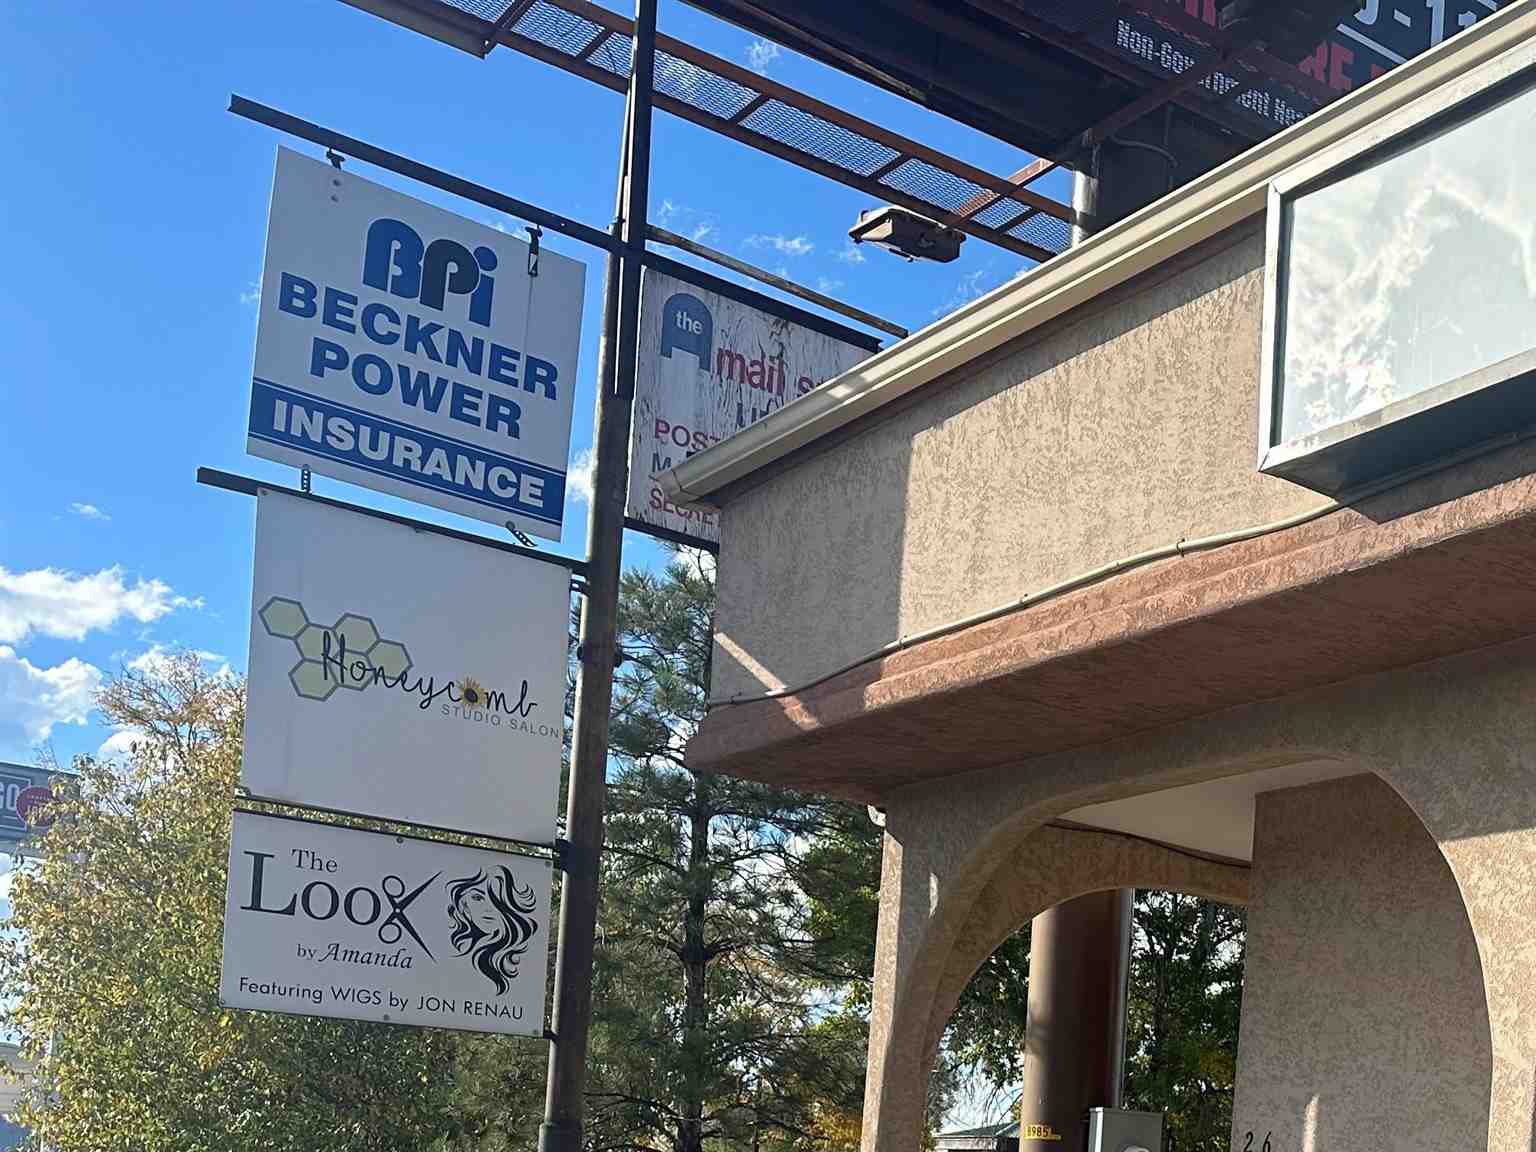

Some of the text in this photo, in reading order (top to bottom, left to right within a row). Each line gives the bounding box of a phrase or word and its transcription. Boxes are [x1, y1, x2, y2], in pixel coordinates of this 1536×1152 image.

[278, 271, 559, 400] BECKNER
[674, 311, 703, 335] the
[310, 336, 522, 439] POWER
[716, 346, 785, 395] mail
[272, 399, 544, 508] INSURANCE
[441, 704, 559, 738] STUDIO SALON
[290, 849, 338, 873] The
[296, 943, 413, 969] by Amanda
[239, 976, 524, 1020] Featuring WIGS by JON RENAU
